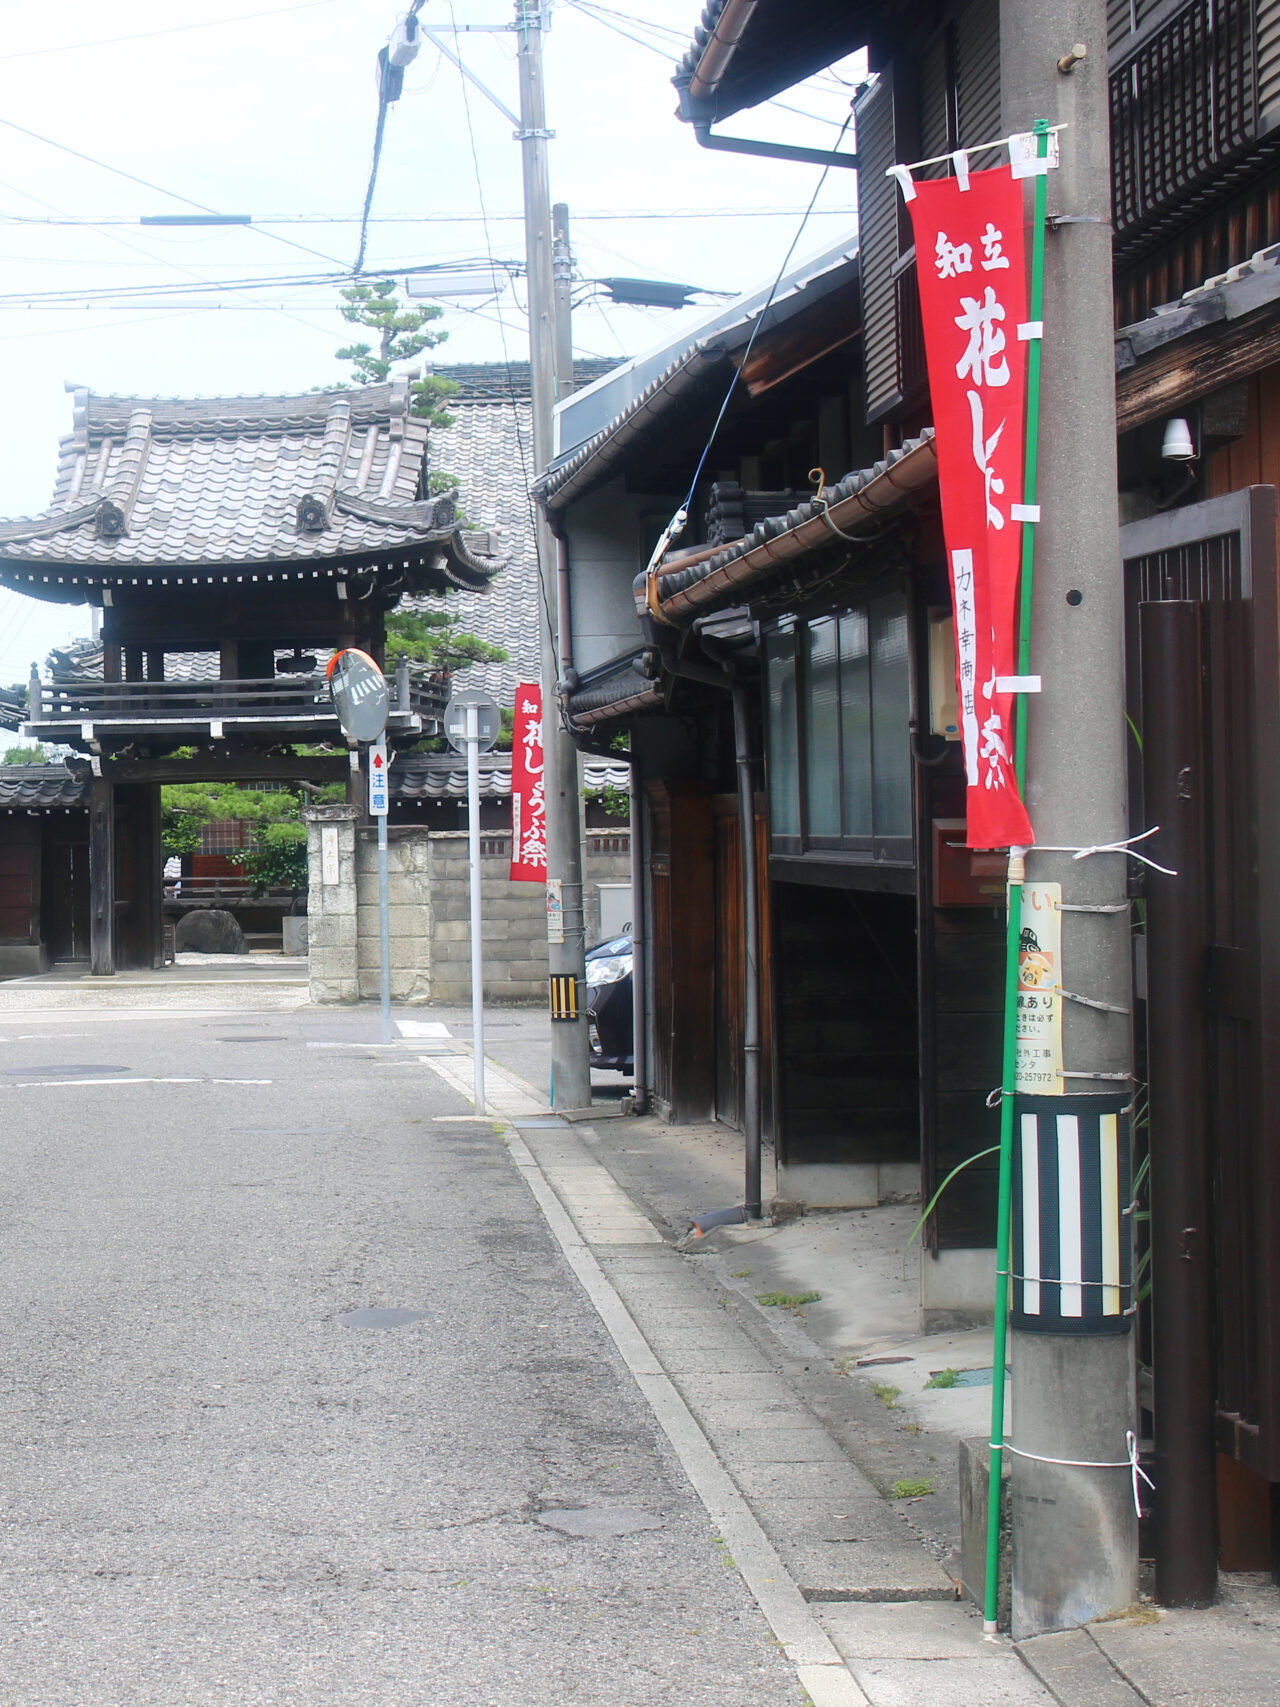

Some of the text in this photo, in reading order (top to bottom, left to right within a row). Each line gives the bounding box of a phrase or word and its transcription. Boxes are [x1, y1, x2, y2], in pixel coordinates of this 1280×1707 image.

[934, 222, 1010, 280] 知立
[956, 566, 974, 716] カネ幸商店
[372, 773, 385, 809] 注意
